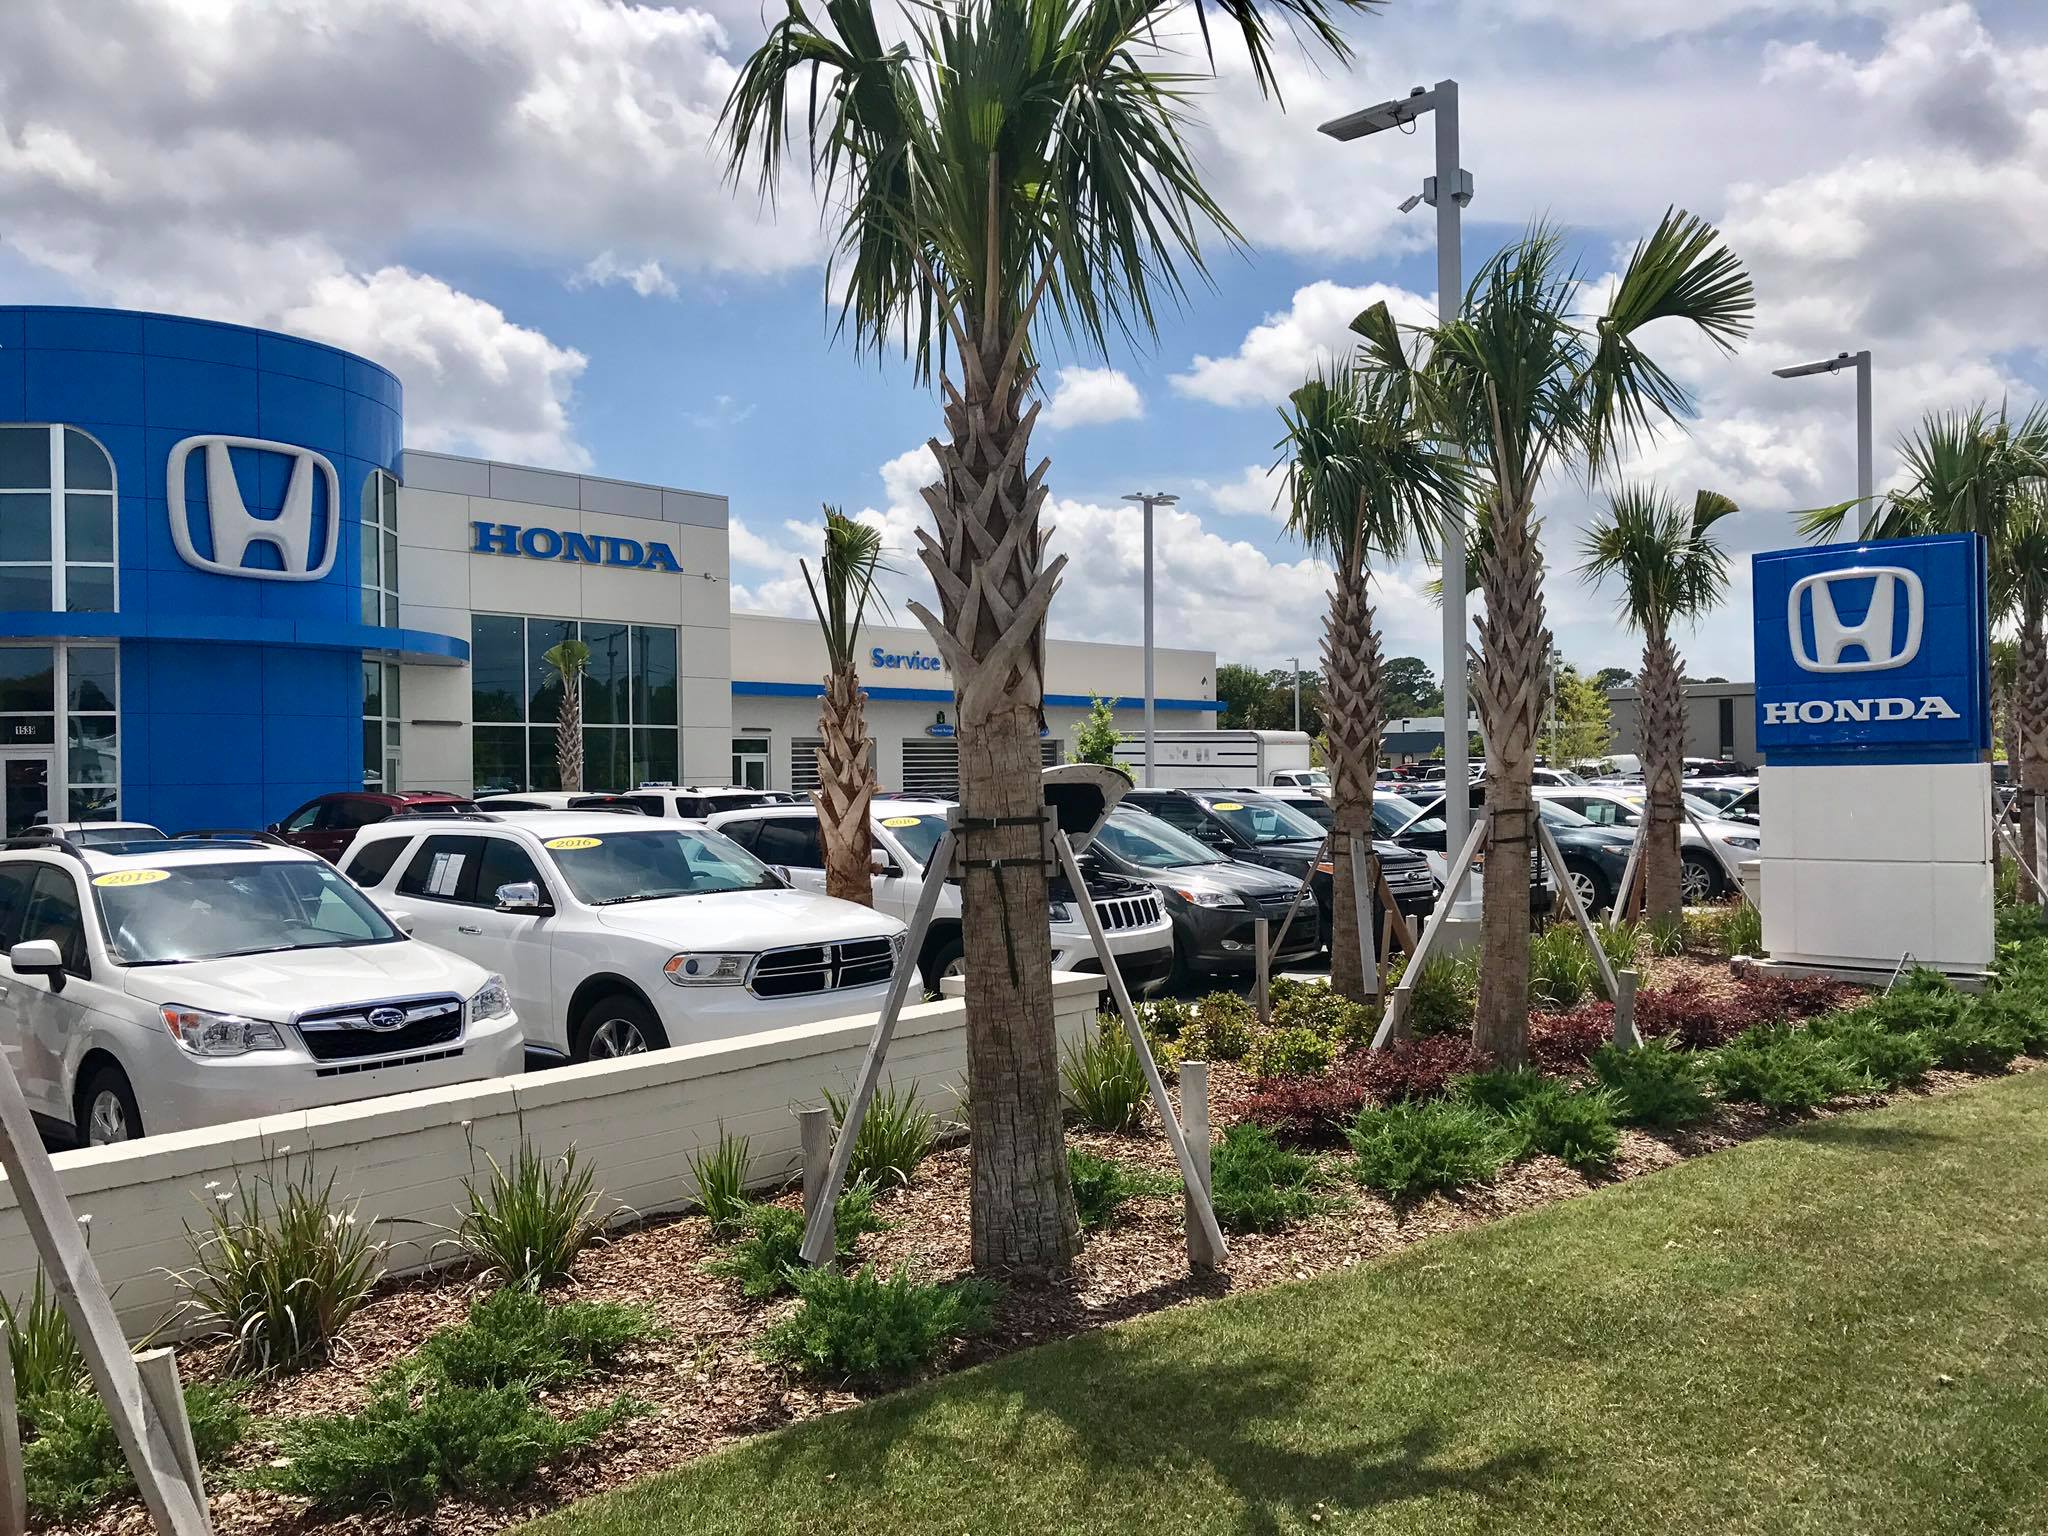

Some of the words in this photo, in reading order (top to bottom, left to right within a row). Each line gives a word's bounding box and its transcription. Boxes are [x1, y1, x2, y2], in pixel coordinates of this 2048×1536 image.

[471, 520, 684, 573] HONDA
[872, 647, 941, 670] Service
[1763, 696, 1961, 724] HONDA
[556, 839, 592, 848] 2016
[107, 871, 157, 884] 2015
